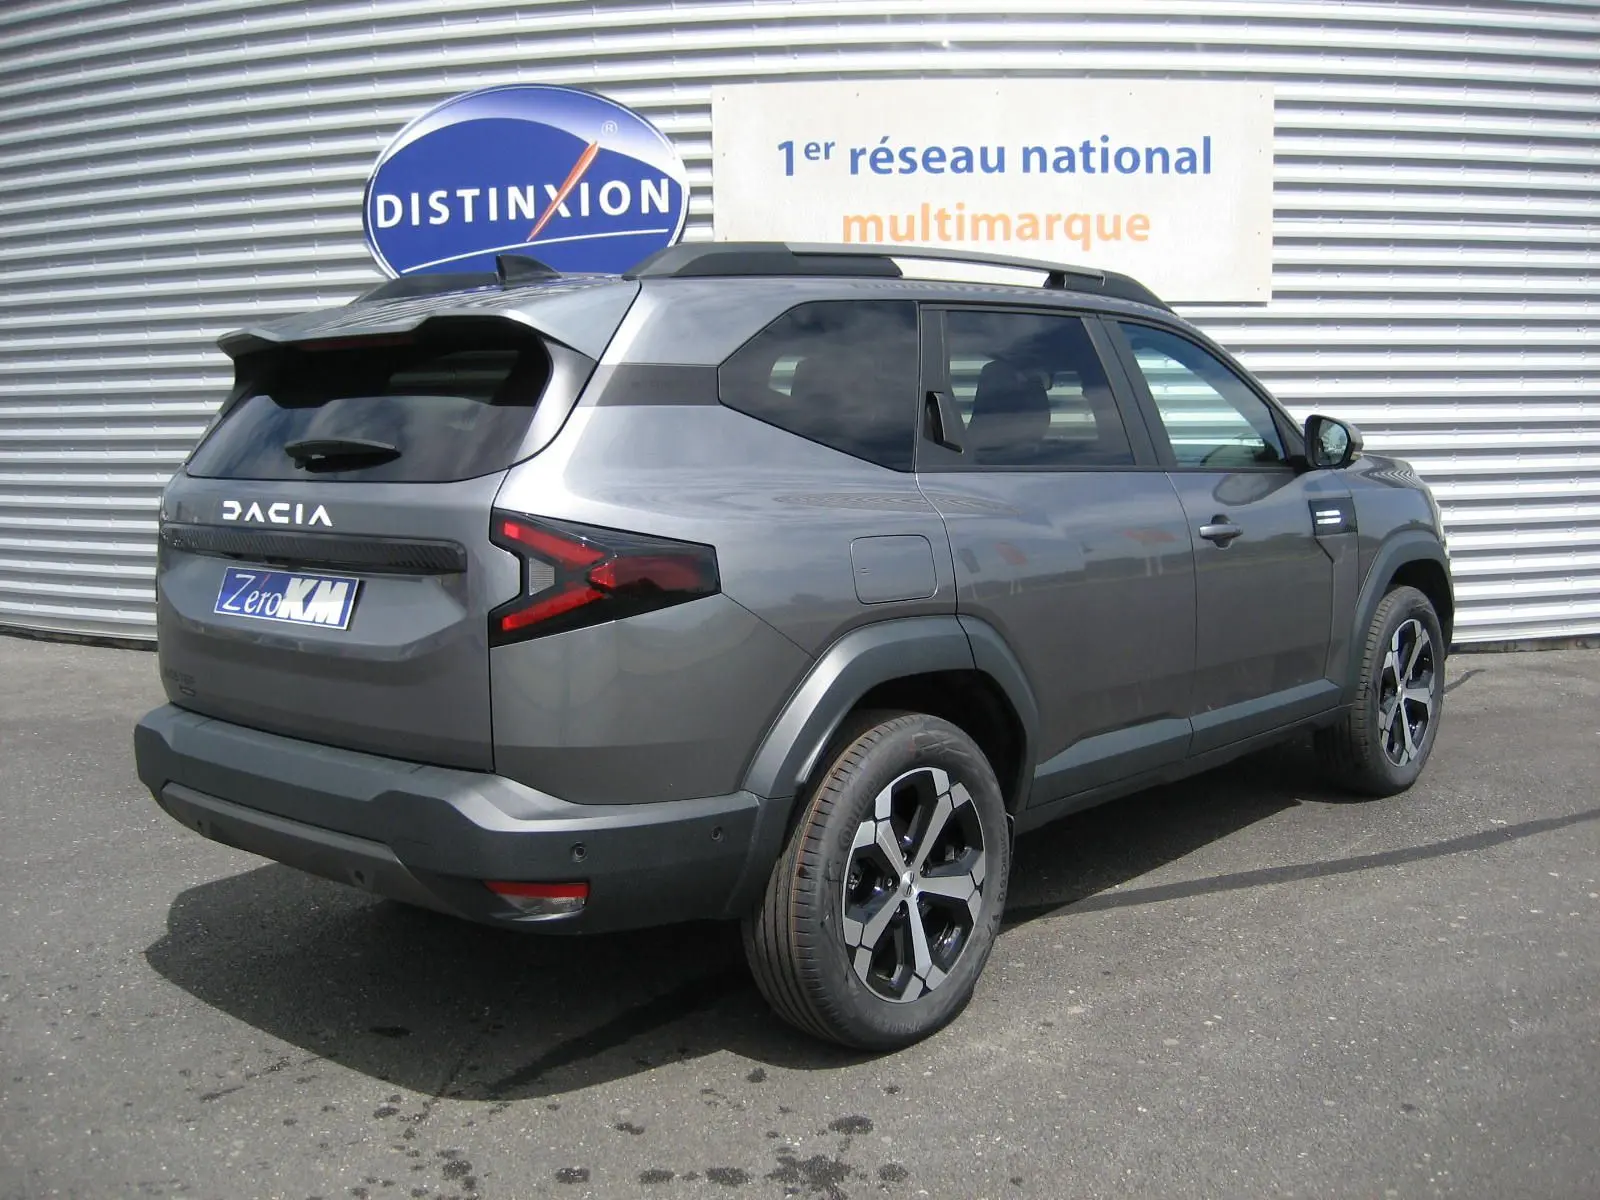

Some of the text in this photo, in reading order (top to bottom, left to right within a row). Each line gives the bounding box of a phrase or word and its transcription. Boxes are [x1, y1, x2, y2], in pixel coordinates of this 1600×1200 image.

[778, 135, 1212, 176] 1er réseau national
[376, 178, 670, 229] DISTINXION
[842, 202, 1151, 251] multimarque
[223, 500, 333, 527] DACIA
